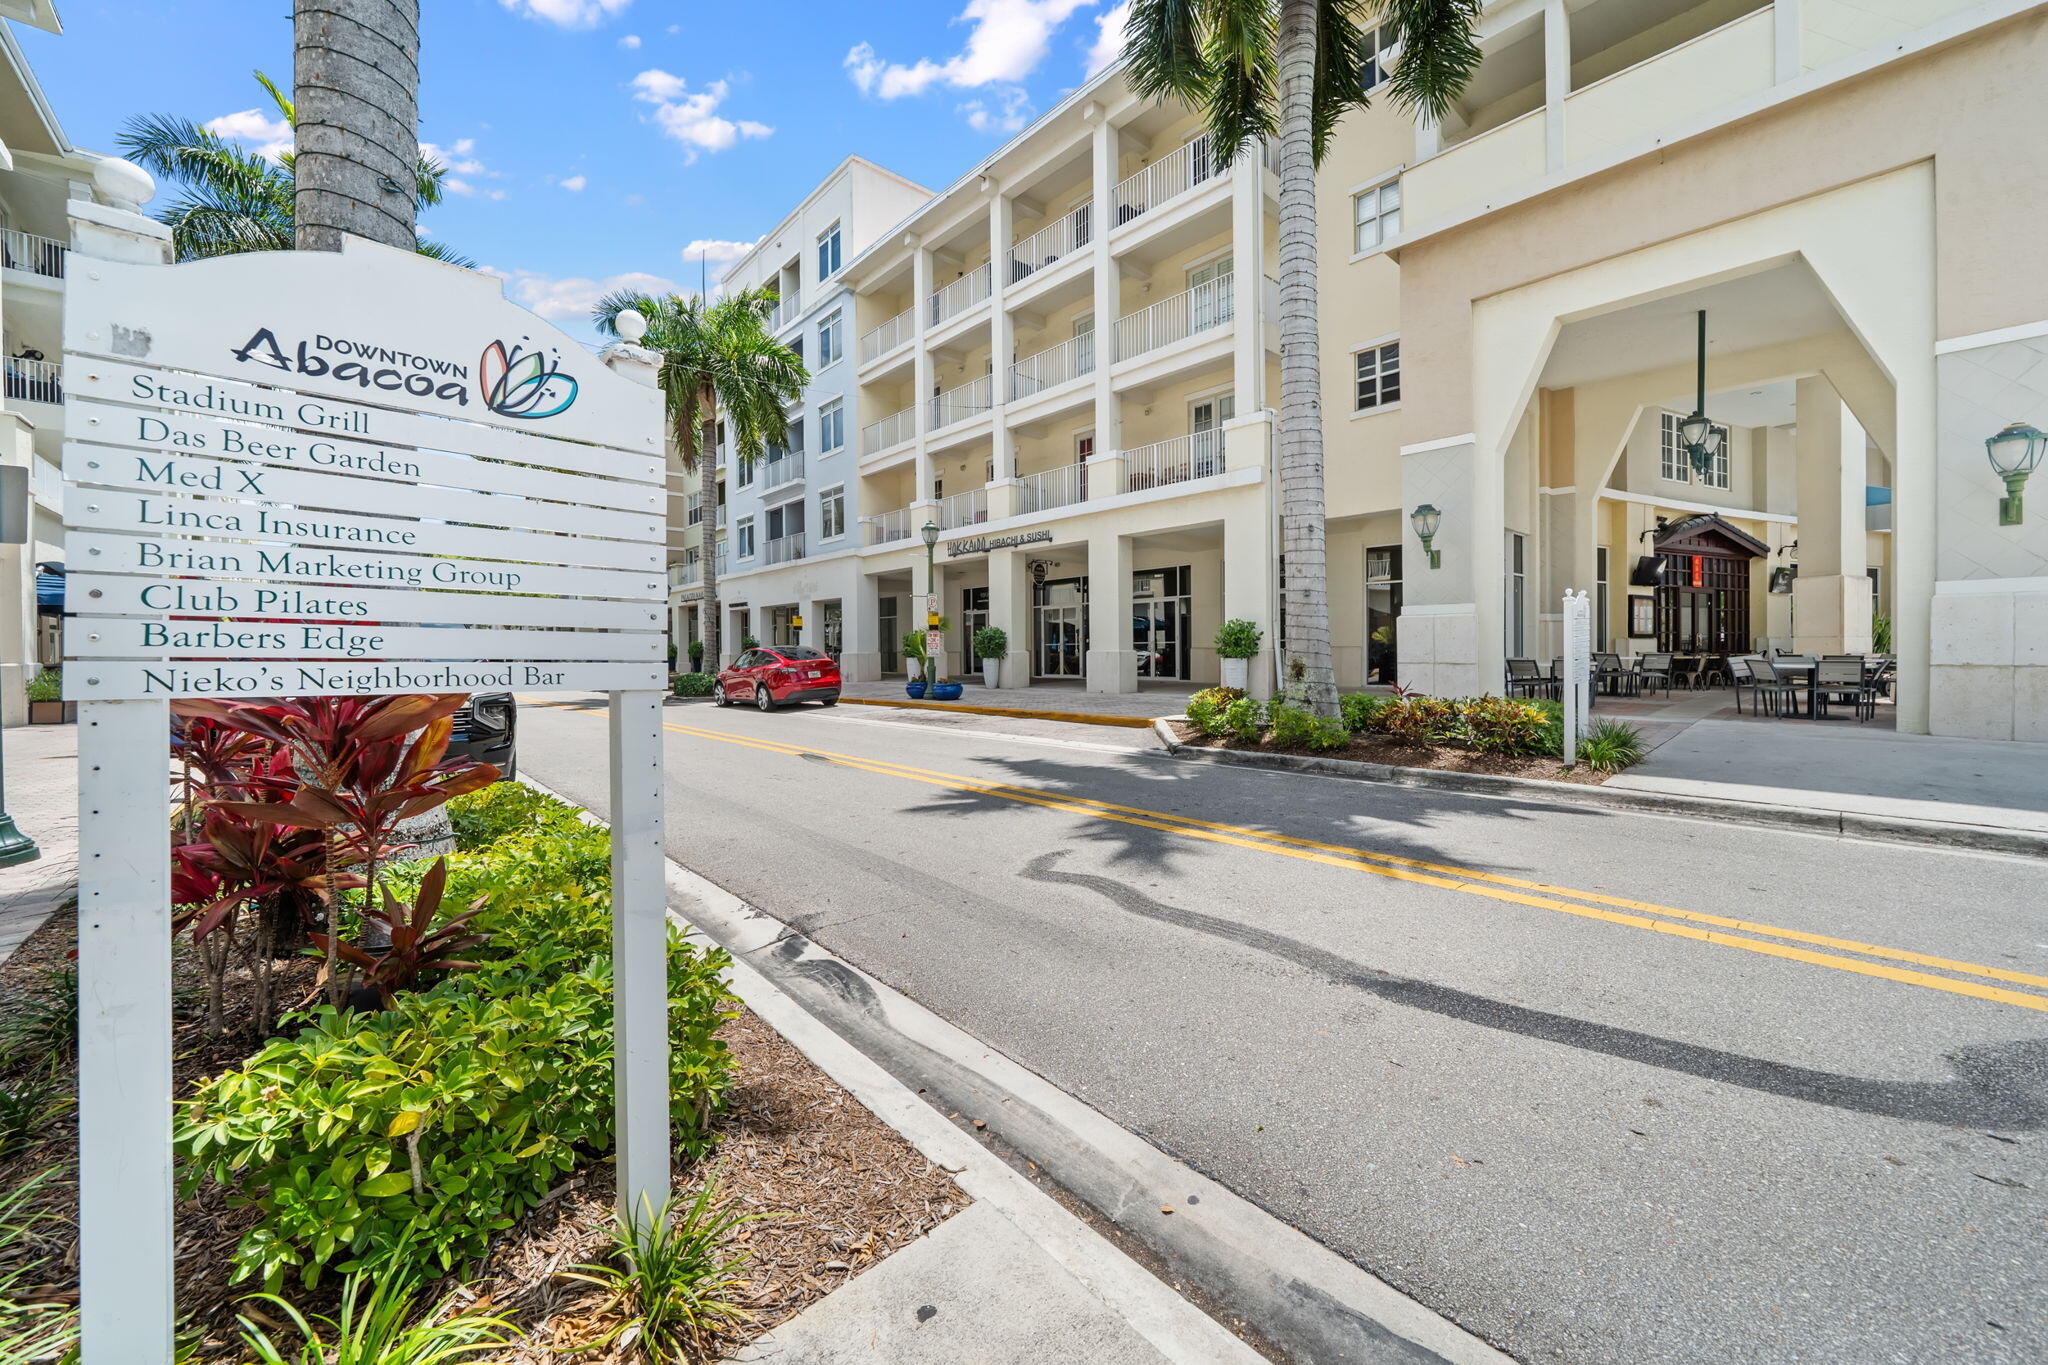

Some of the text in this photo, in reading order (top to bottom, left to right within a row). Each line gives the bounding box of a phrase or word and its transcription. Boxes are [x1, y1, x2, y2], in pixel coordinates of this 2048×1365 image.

[230, 327, 469, 407] Abacoa
[316, 335, 468, 380] DOWNTOWN
[132, 373, 370, 435] Stadium Grill
[137, 416, 421, 478] Das Beer Garden
[136, 457, 265, 496] Med X
[138, 499, 416, 548] Linca Insurance
[990, 537, 1018, 549] HIBACHI
[1019, 534, 1025, 543] &
[1026, 530, 1050, 541] SUSHI
[137, 542, 521, 591] Brian Marketing Group
[140, 584, 368, 616] Club Pilates
[139, 622, 384, 657] Barbers Edge
[141, 665, 566, 694] Nieko's Neighborhood Bar
